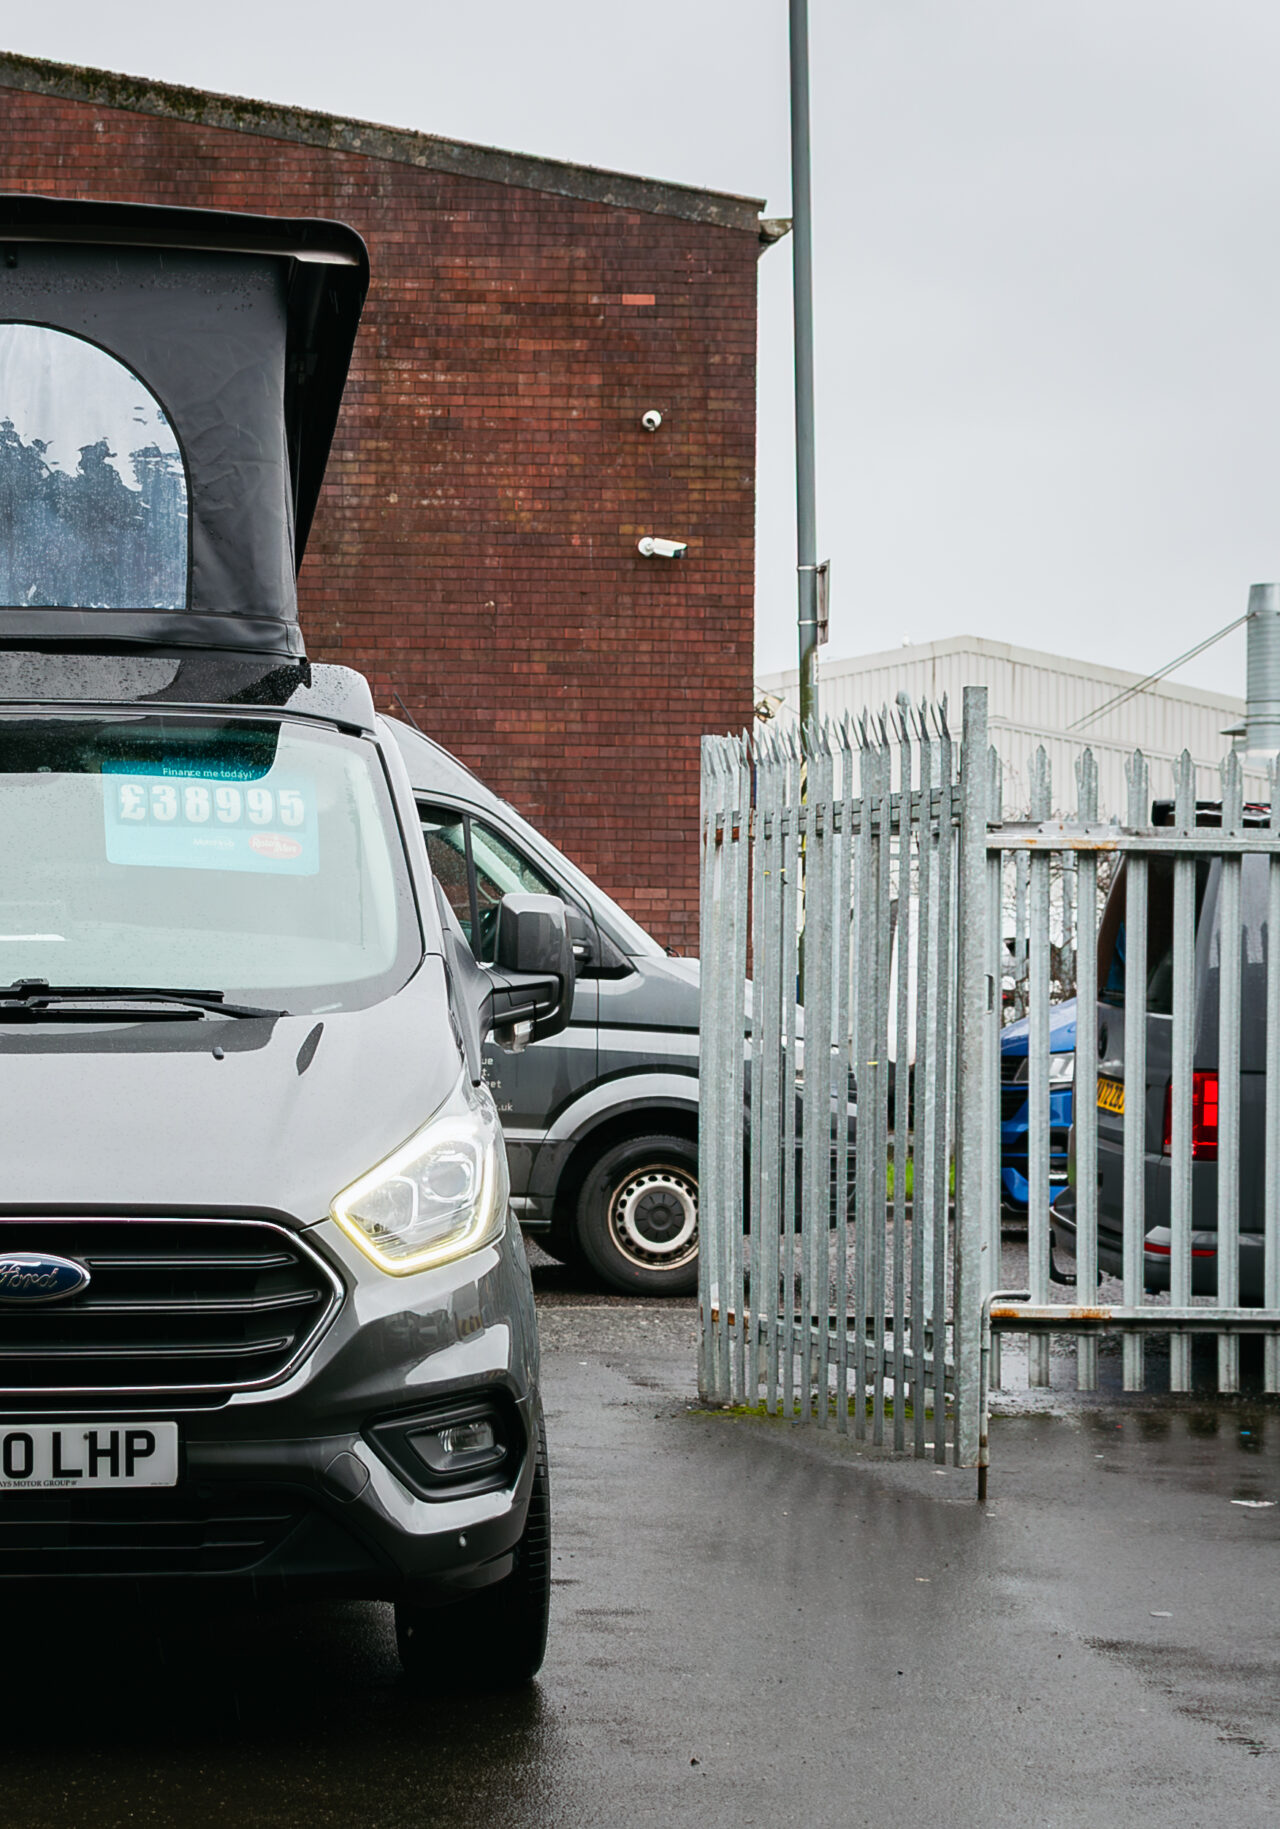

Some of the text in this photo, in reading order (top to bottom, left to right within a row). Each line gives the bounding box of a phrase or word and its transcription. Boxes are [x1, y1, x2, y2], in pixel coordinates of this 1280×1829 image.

[162, 767, 201, 777] Finance
[203, 770, 219, 778] me
[120, 784, 305, 826] £38995
[52, 1429, 156, 1478] LHP
[43, 1479, 71, 1487] GROUP
